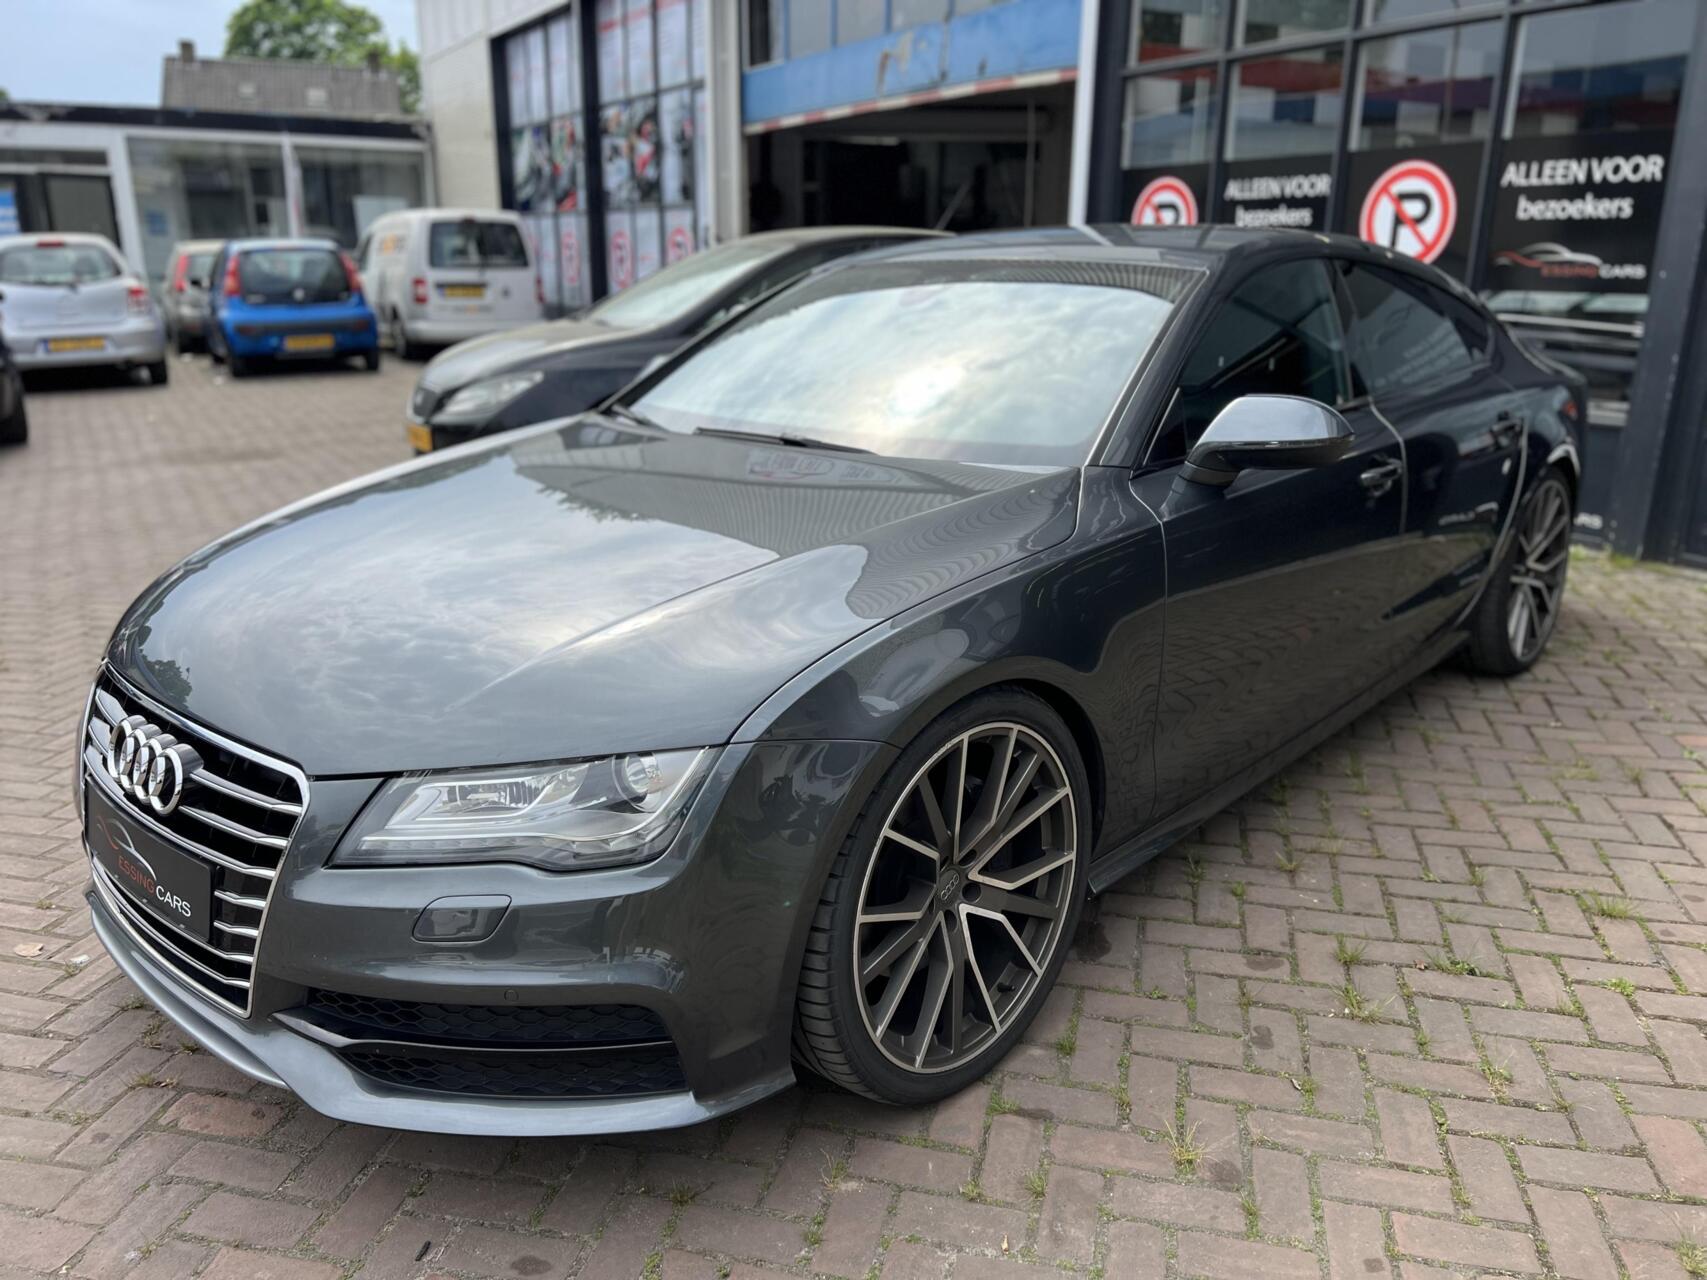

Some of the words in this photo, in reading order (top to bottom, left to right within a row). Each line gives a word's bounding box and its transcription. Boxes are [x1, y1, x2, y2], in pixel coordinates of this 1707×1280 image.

[1500, 160, 1588, 187] ALLEEN
[1590, 154, 1665, 184] VOOR
[1223, 177, 1280, 201] ALLEEN
[1281, 173, 1331, 199] VOOR
[1515, 191, 1634, 220] bezoekers
[118, 855, 155, 894] ESSING
[155, 885, 191, 917] CARS
